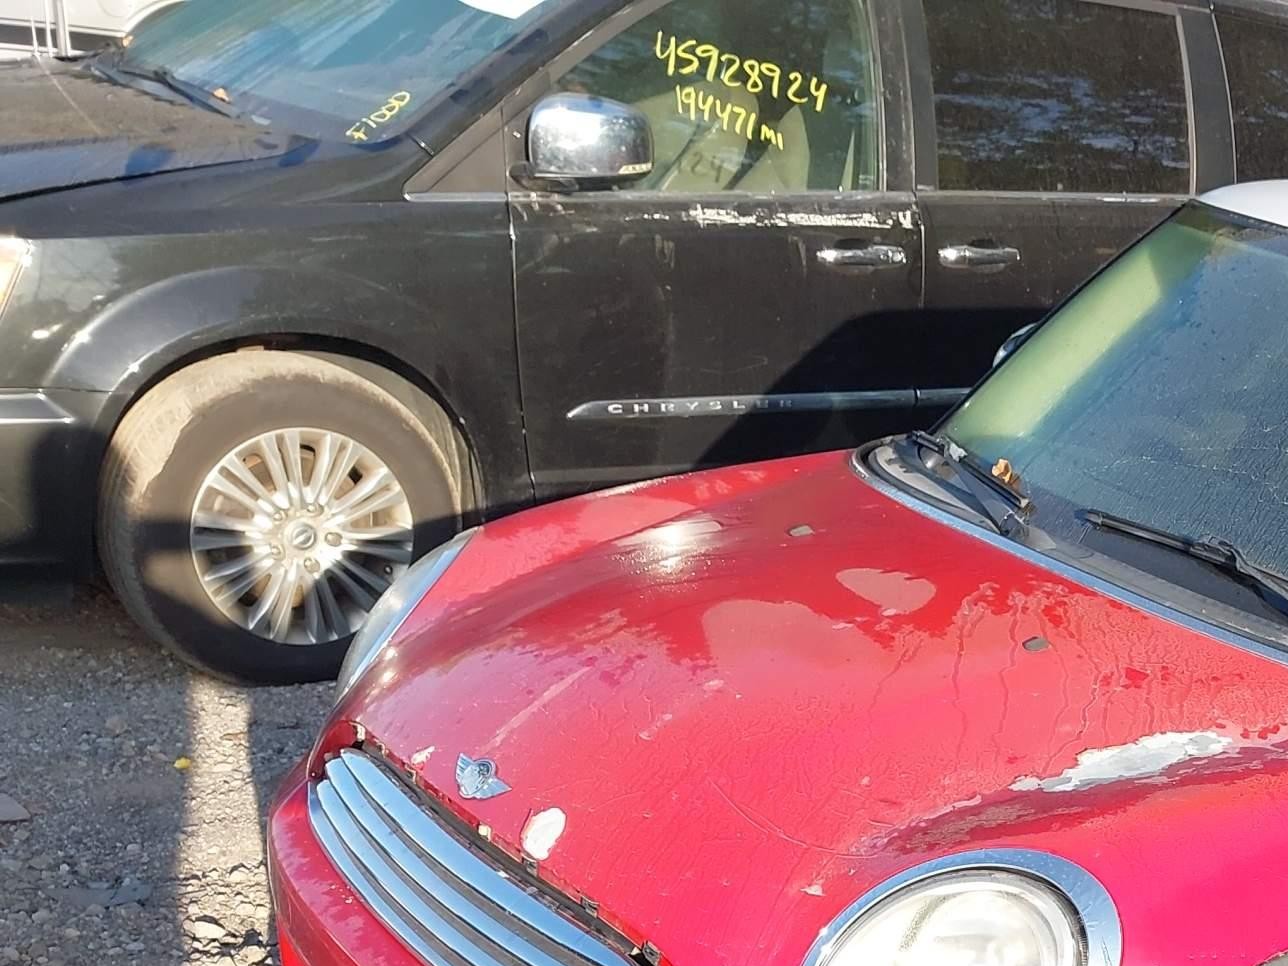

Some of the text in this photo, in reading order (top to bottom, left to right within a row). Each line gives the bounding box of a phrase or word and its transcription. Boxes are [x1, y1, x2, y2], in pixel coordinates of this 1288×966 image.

[654, 29, 828, 112] 45928924
[674, 83, 757, 141] 194471
[606, 400, 792, 414] CHRYSLER
